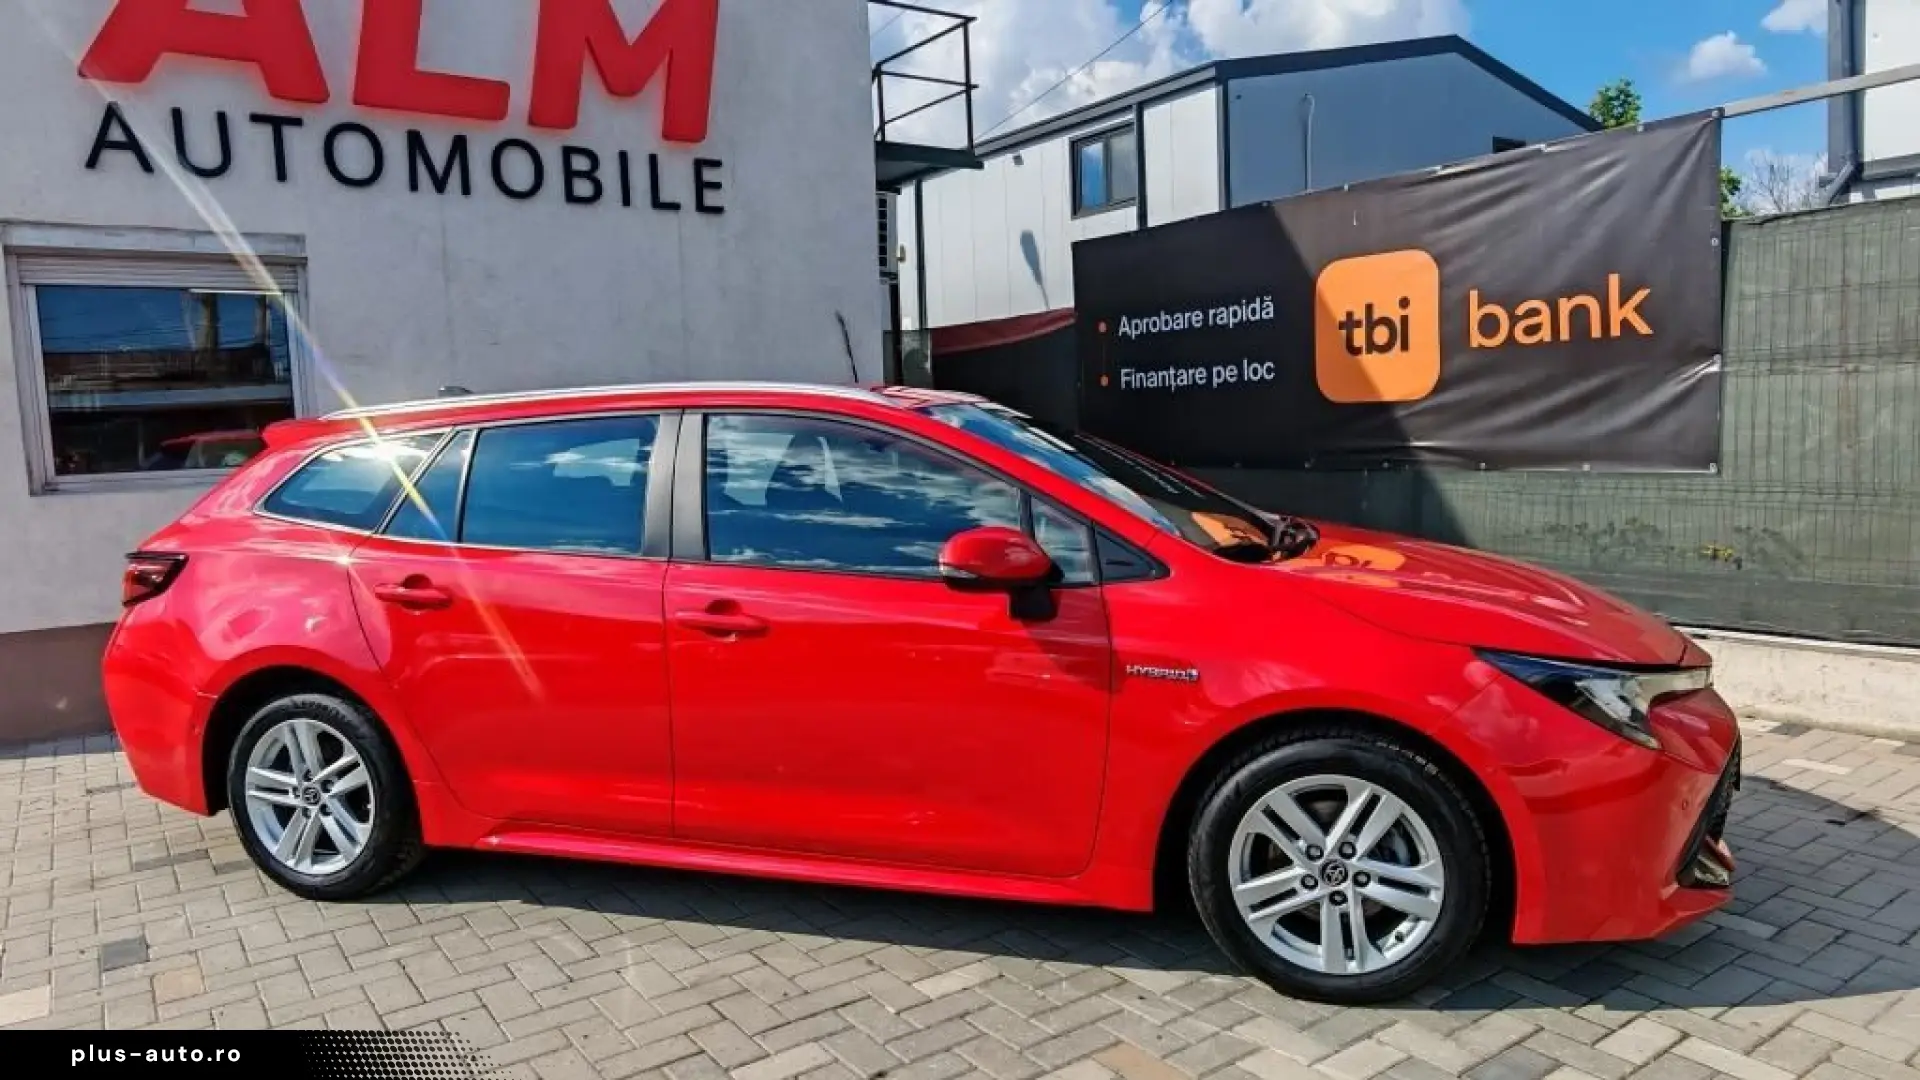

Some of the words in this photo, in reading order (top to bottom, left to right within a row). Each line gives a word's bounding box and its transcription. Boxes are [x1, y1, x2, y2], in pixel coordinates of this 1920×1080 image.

[84, 101, 725, 215] AUTOMOBILE
[1118, 303, 1203, 337] Aprobare
[1208, 296, 1275, 330] rapidă
[1337, 296, 1411, 358] tbi
[1467, 273, 1654, 348] bank
[1212, 361, 1238, 387] pe
[1243, 358, 1276, 382] loc
